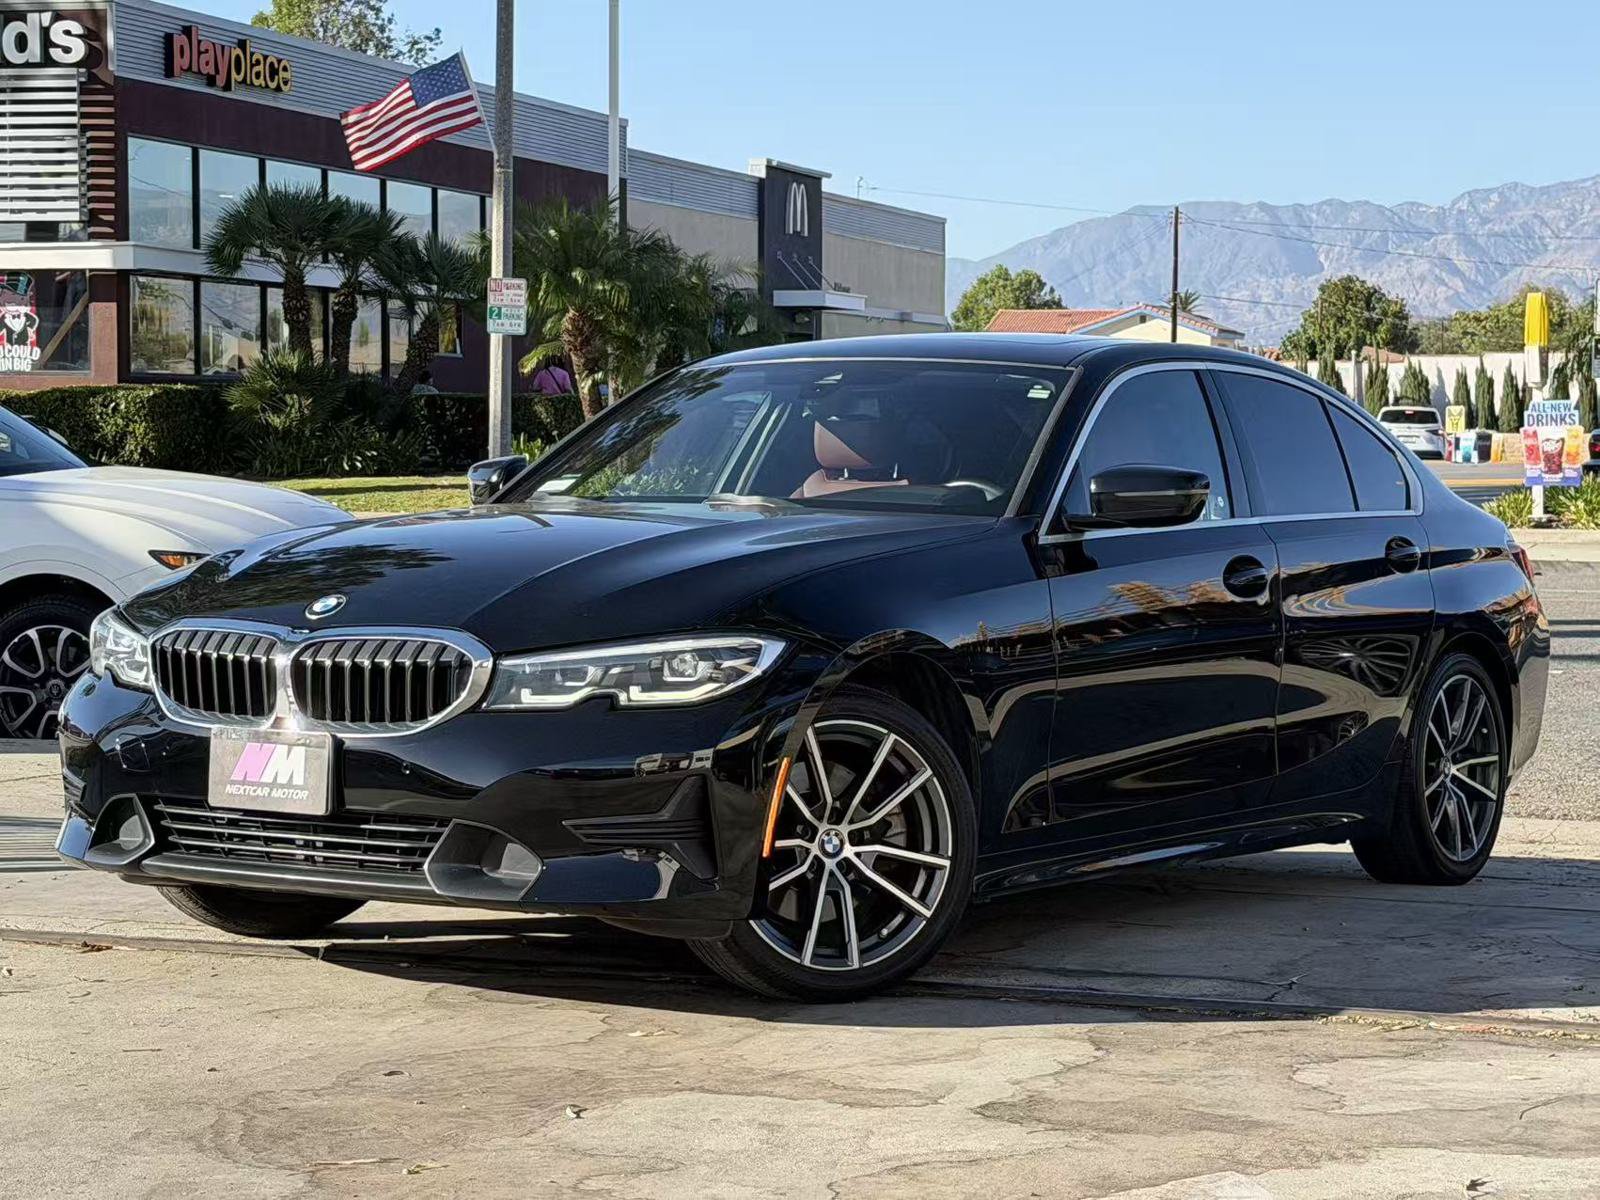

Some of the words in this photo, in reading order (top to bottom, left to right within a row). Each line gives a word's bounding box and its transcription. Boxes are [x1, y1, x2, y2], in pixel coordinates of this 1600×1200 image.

[172, 24, 293, 92] playplace
[491, 307, 500, 319] 2
[4, 342, 41, 361] COULD
[13, 357, 32, 372] BIG
[1530, 402, 1572, 413] ALL-NEW
[1527, 412, 1577, 427] DRINKS
[225, 783, 270, 797] NEXTCAR
[271, 787, 309, 800] MOTOR
